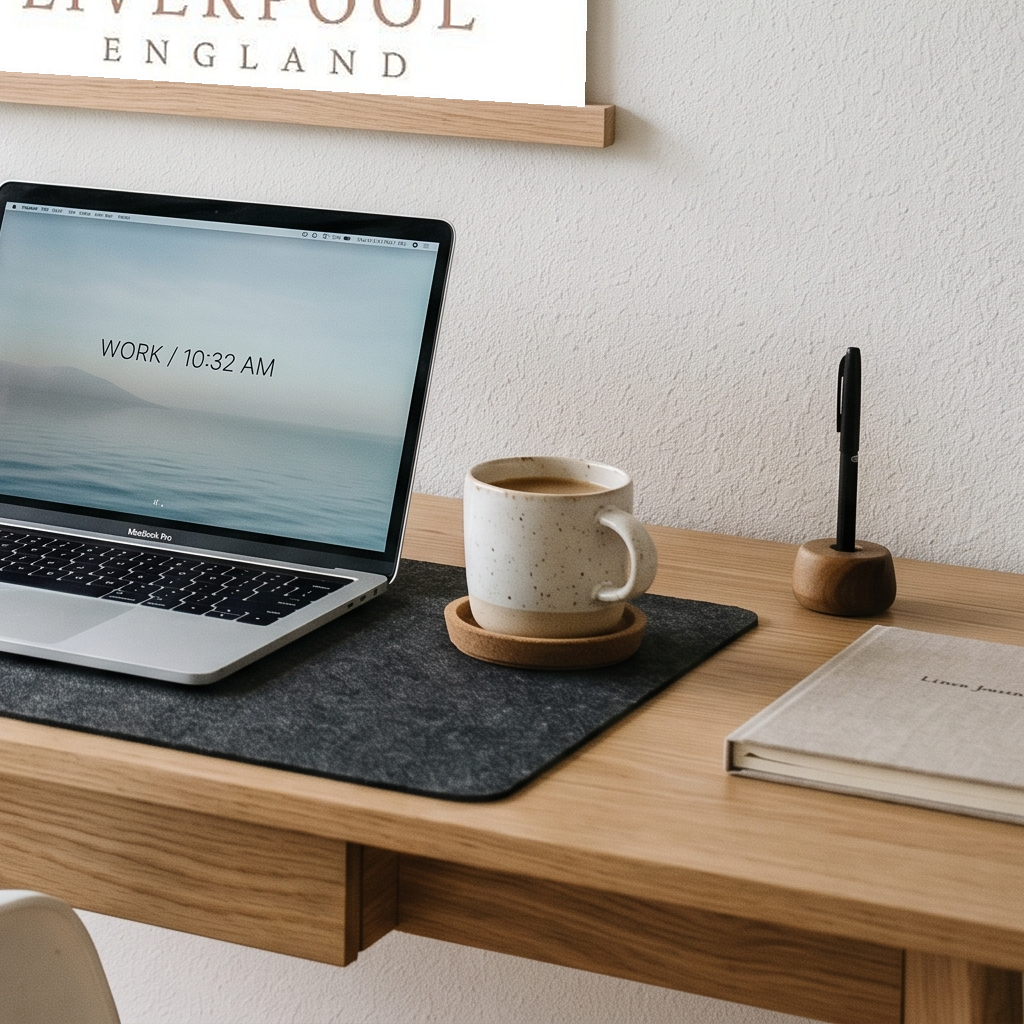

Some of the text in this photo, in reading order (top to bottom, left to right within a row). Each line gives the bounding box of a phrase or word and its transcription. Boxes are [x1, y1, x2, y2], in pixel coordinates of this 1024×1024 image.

[103, 37, 407, 78] ENGLAND
[101, 338, 276, 378] WORK / 10:32 AM
[160, 532, 172, 542] Pro
